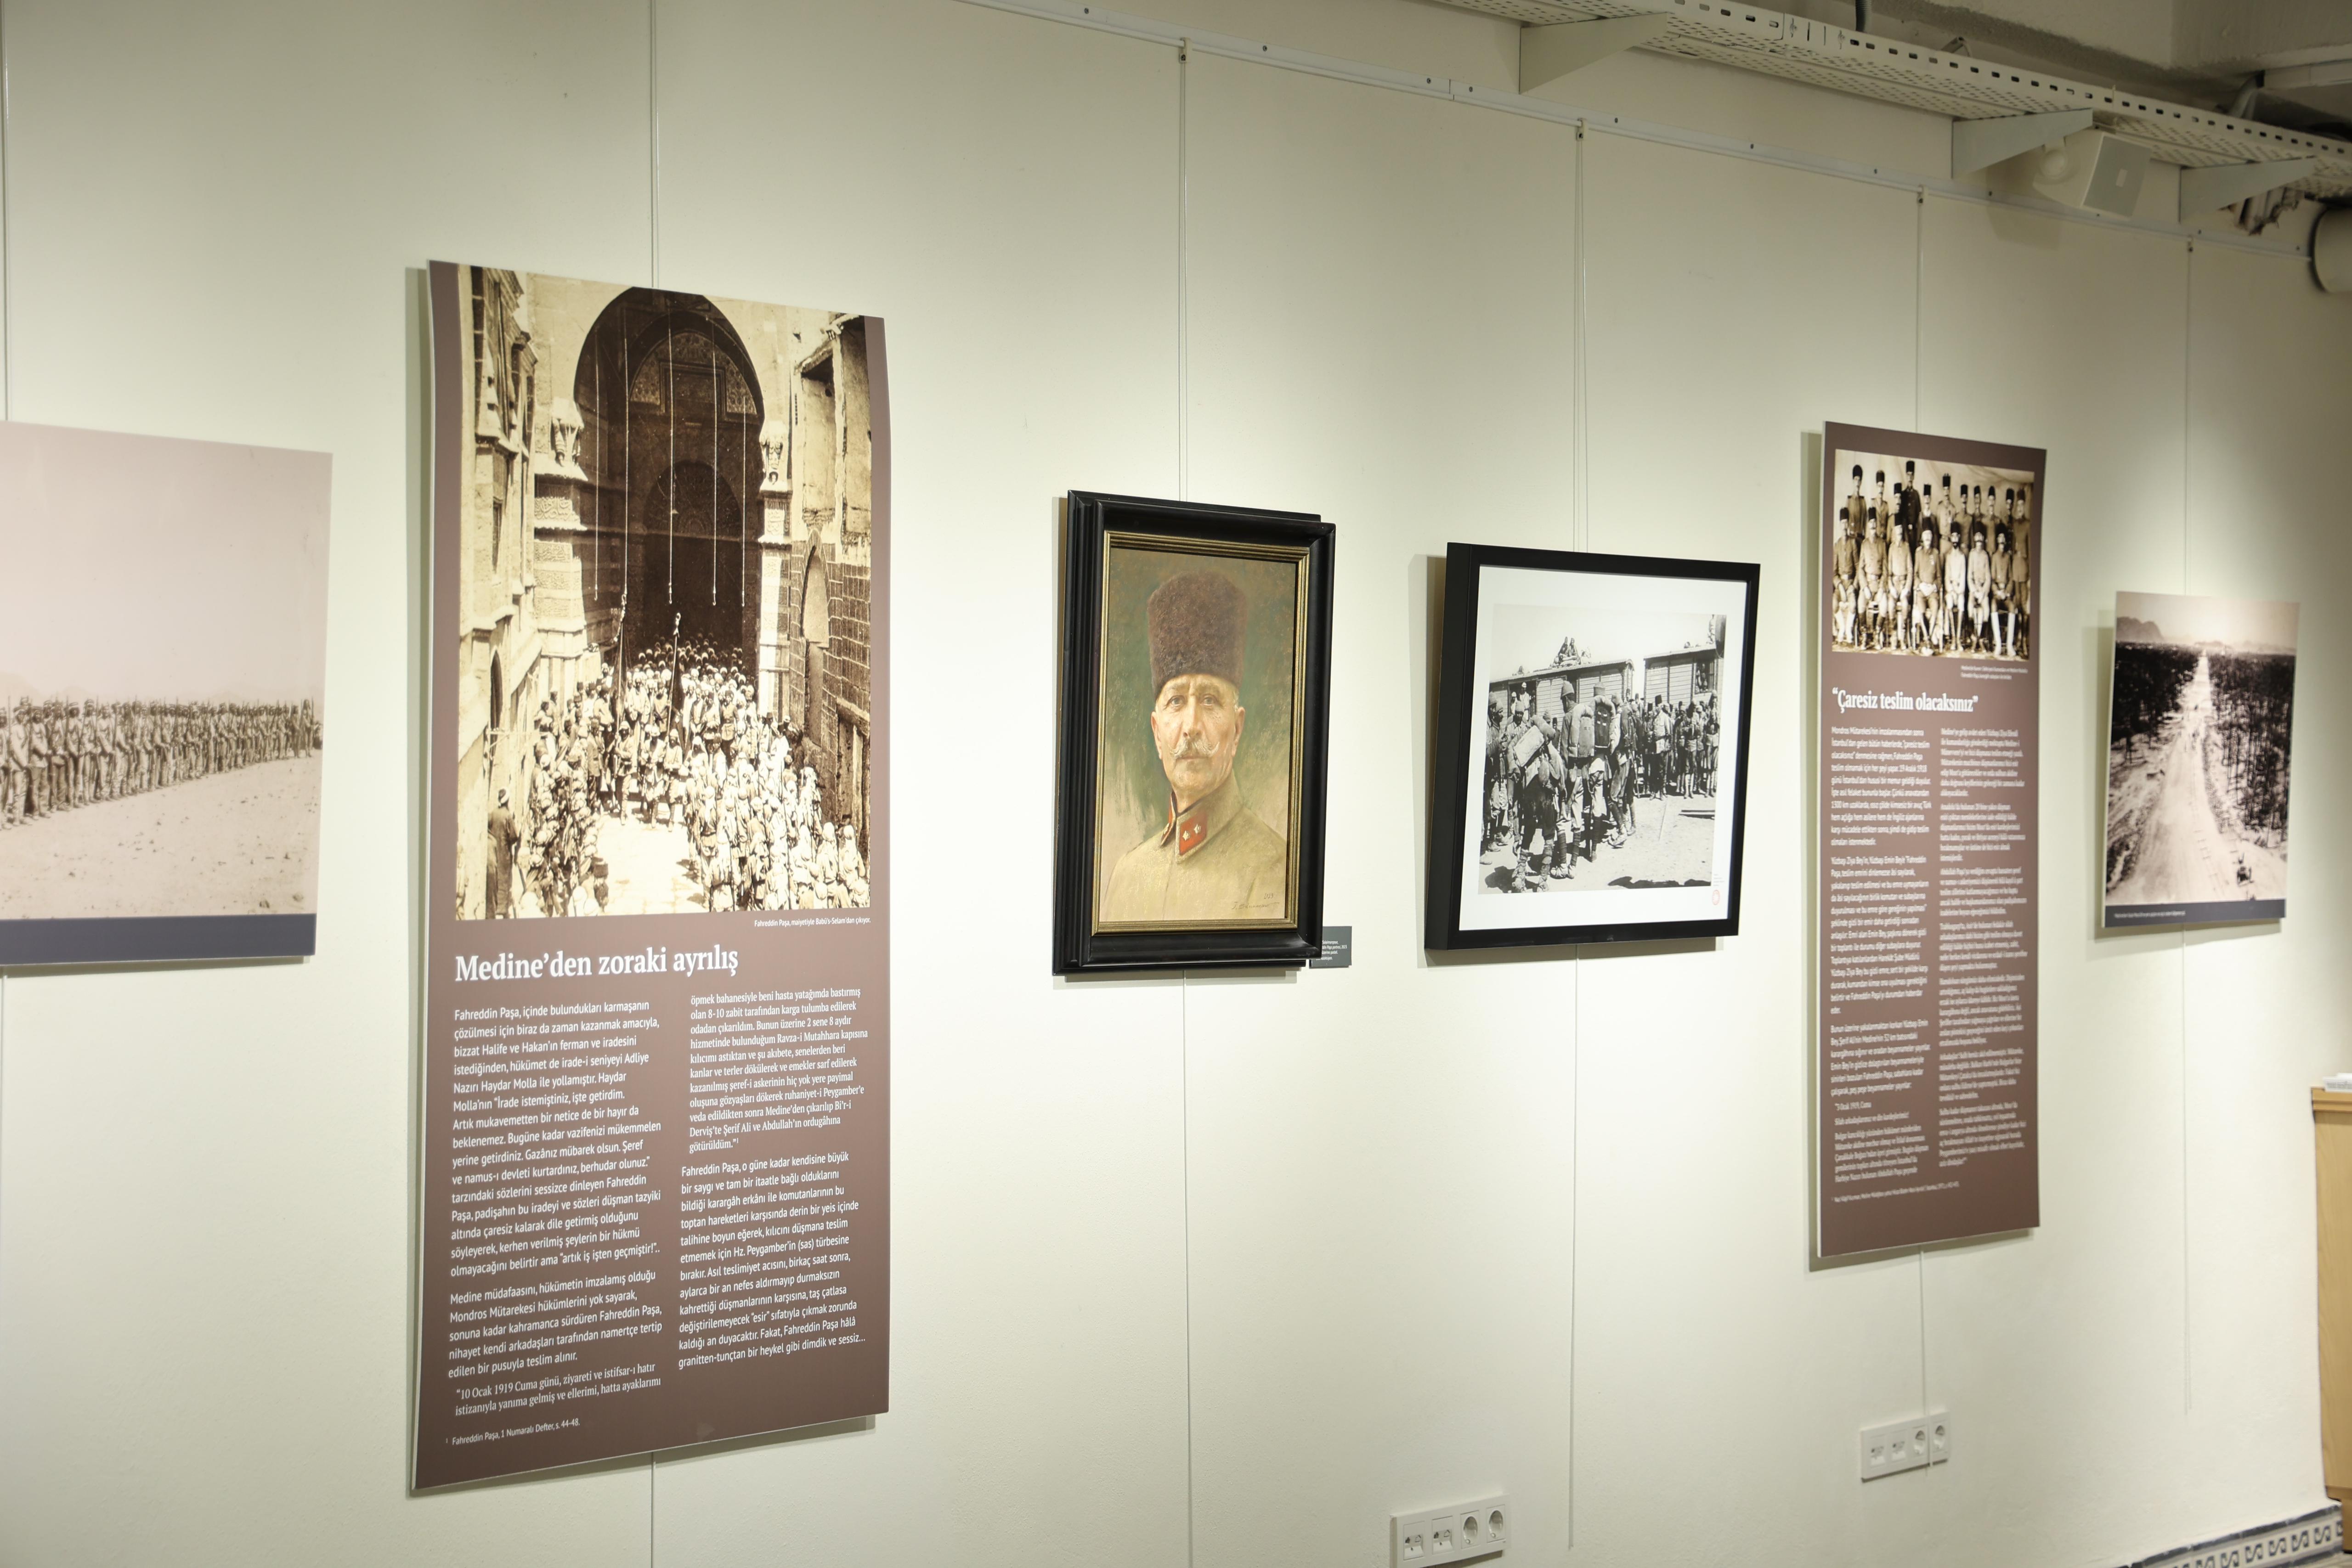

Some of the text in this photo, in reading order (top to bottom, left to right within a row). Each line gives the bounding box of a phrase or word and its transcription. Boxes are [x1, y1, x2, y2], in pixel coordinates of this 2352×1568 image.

[1879, 691, 1914, 710] teslim
[598, 947, 667, 975] zoraki
[673, 944, 738, 977] ayrılış
[690, 987, 861, 1007] öpmek bahanesiyle beni hasta yatağımda bastırmış
[455, 1002, 649, 1021] Fahreddin Paşa, içinde bulundukları karmaşanın
[690, 1009, 707, 1020] olan
[725, 1007, 743, 1017] zabit
[745, 1005, 780, 1016] tarafından
[781, 1004, 800, 1016] karga
[801, 1002, 829, 1013] tulumba
[830, 1000, 857, 1011] edilerek
[454, 1016, 660, 1042] çözülmesi için biraz da zaman kazanmak amacıyla,
[690, 1037, 730, 1049] hizmetinde
[732, 1035, 775, 1047] bulunduğum
[804, 1030, 840, 1042] Mutahhara
[841, 1029, 868, 1041] kapısına
[454, 1046, 480, 1058] bizzat
[482, 1043, 508, 1055] Halife
[509, 1045, 520, 1054] ve
[560, 1039, 589, 1050] ferman
[591, 1040, 600, 1048] ve
[603, 1035, 637, 1048] iradesini
[454, 1052, 649, 1077] istediğinden, hükümet de irade-i seniyeyi Adliye
[454, 1071, 627, 1094] Nazırı Haydar Molla ile yollamıştır. Haydar
[521, 1093, 571, 1107] istemiştiniz,
[572, 1092, 587, 1105] işte
[589, 1089, 625, 1104] getirdim.
[452, 1105, 639, 1130] Artık mukavemetten bir netice de bir hayır da
[452, 1121, 661, 1149] beklenemez. Bugüne kadar vazifenizi mükemmelen
[452, 1139, 644, 1170] yerine getirdiniz. Gazânız mübarek olsun. Şeref
[682, 1151, 849, 1177] Fahreddin Paşa, o güne kadar kendisine büyük
[681, 1170, 839, 1195] bir saygı ve tam bir itaatle bağlı olduklarını
[680, 1249, 716, 1263] etmemek
[718, 1248, 732, 1261] için
[734, 1247, 746, 1257] Hz.
[798, 1238, 814, 1252] (sas)
[816, 1235, 849, 1247] türbesine
[451, 1261, 507, 1277] olmayacağını
[509, 1256, 539, 1270] belirtir
[540, 1256, 558, 1266] ama
[583, 1250, 590, 1263] iş
[593, 1249, 612, 1263] işten
[450, 1269, 656, 1305] Medine müdafaasını, hükümetin imzalamış olduğu
[450, 1289, 637, 1323] Mondros Mütarekesi hükümlerini yok sayarak,
[680, 1286, 847, 1315] kahrettiği düşmanlarının karşısına, taş çatlasa
[472, 1385, 492, 1398] Ocak
[495, 1382, 514, 1395] 1919
[514, 1381, 537, 1392] Cuma
[539, 1376, 561, 1390] günü,
[563, 1371, 592, 1386] ziyareti
[594, 1371, 603, 1380] ve
[604, 1366, 635, 1378] istifsar-ı
[637, 1363, 656, 1374] hatır
[452, 1433, 483, 1445] Fahreddin
[506, 1425, 534, 1437] Numaralı
